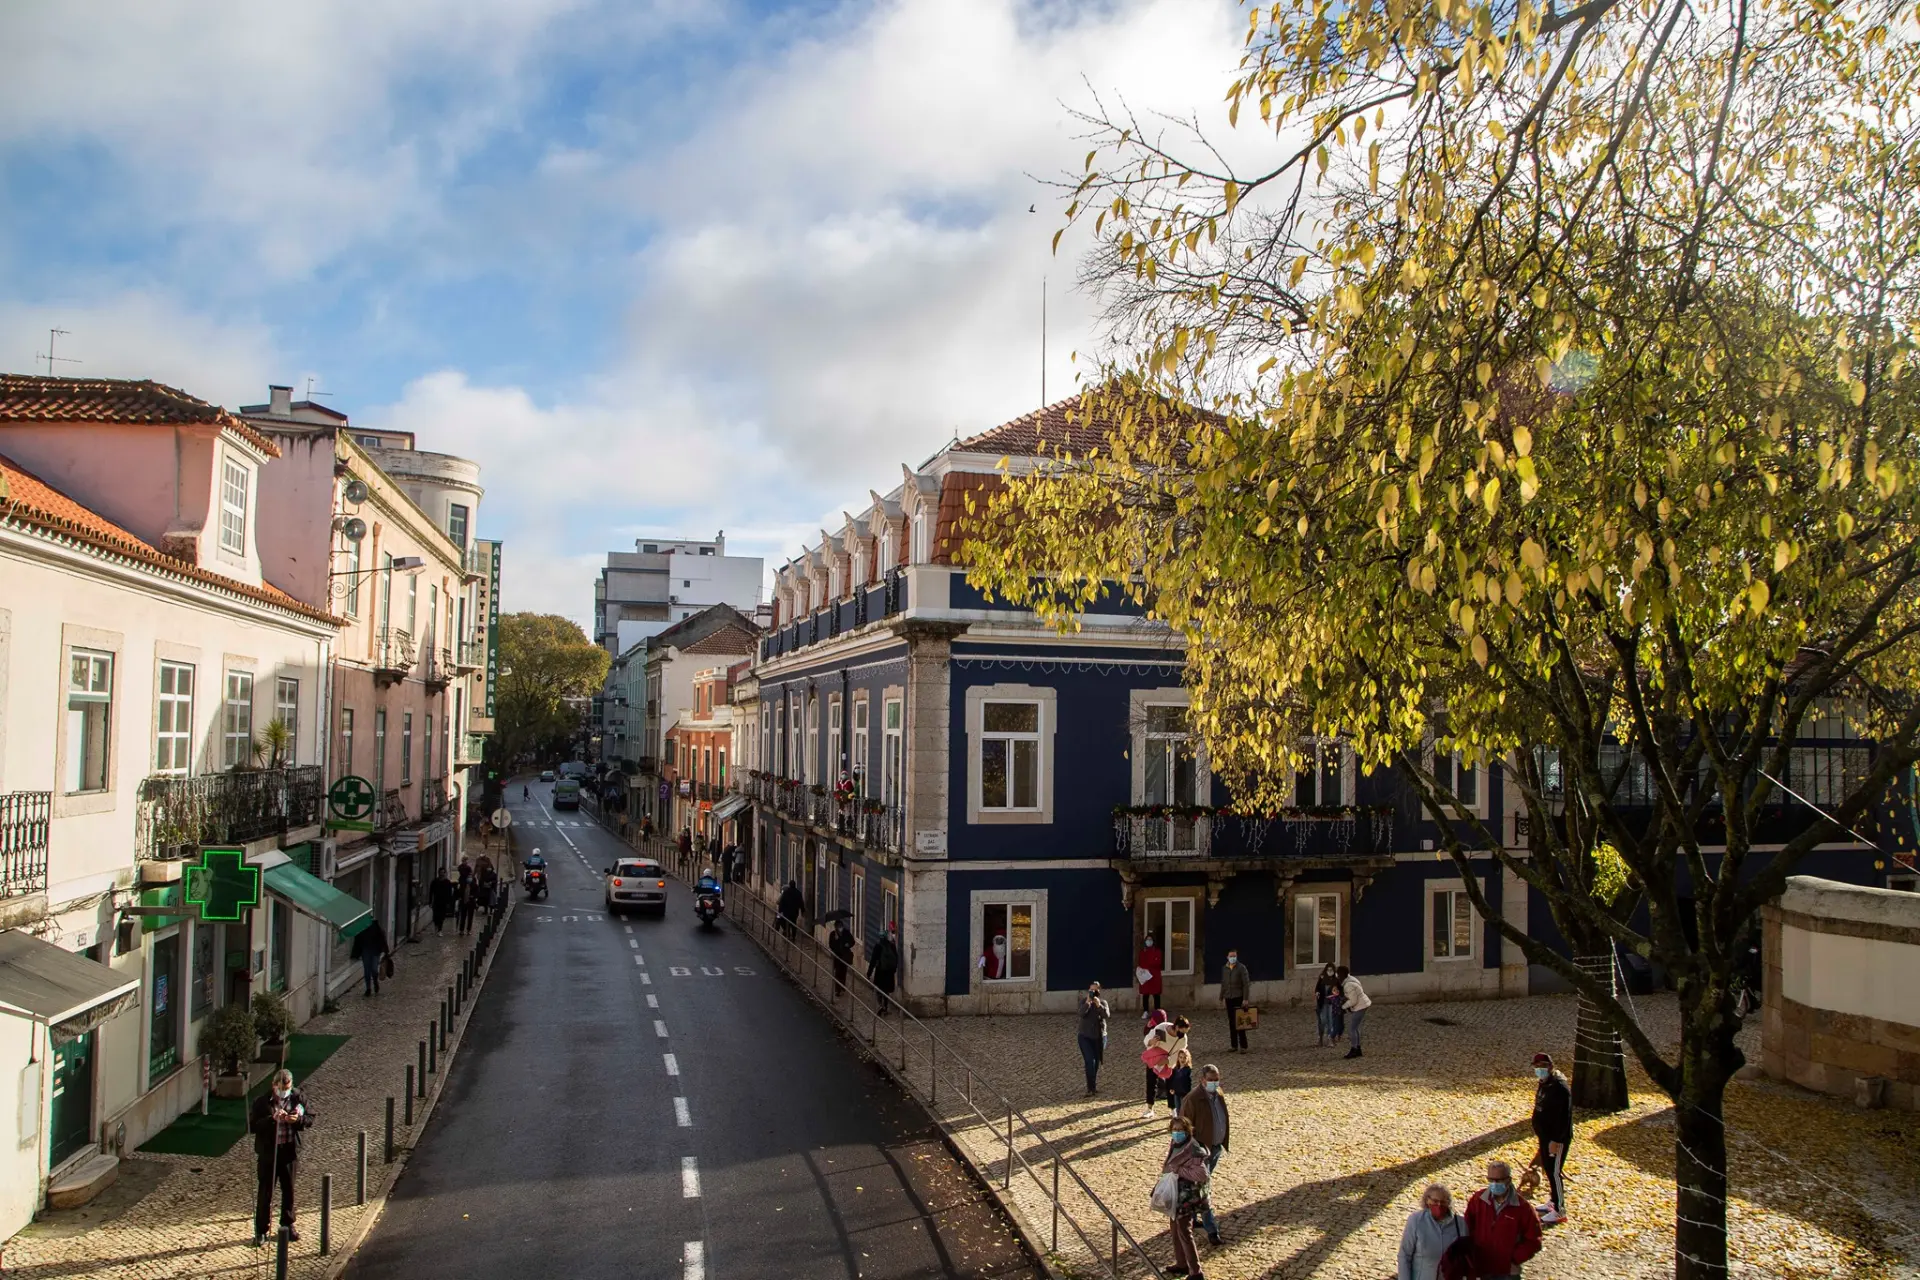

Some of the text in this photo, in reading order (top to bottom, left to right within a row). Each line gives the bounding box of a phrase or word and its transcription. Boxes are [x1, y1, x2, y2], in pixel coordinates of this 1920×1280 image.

[476, 578, 486, 682] EXTERNO
[487, 546, 500, 716] ALVARES CABRAL
[669, 966, 756, 977] BUS
